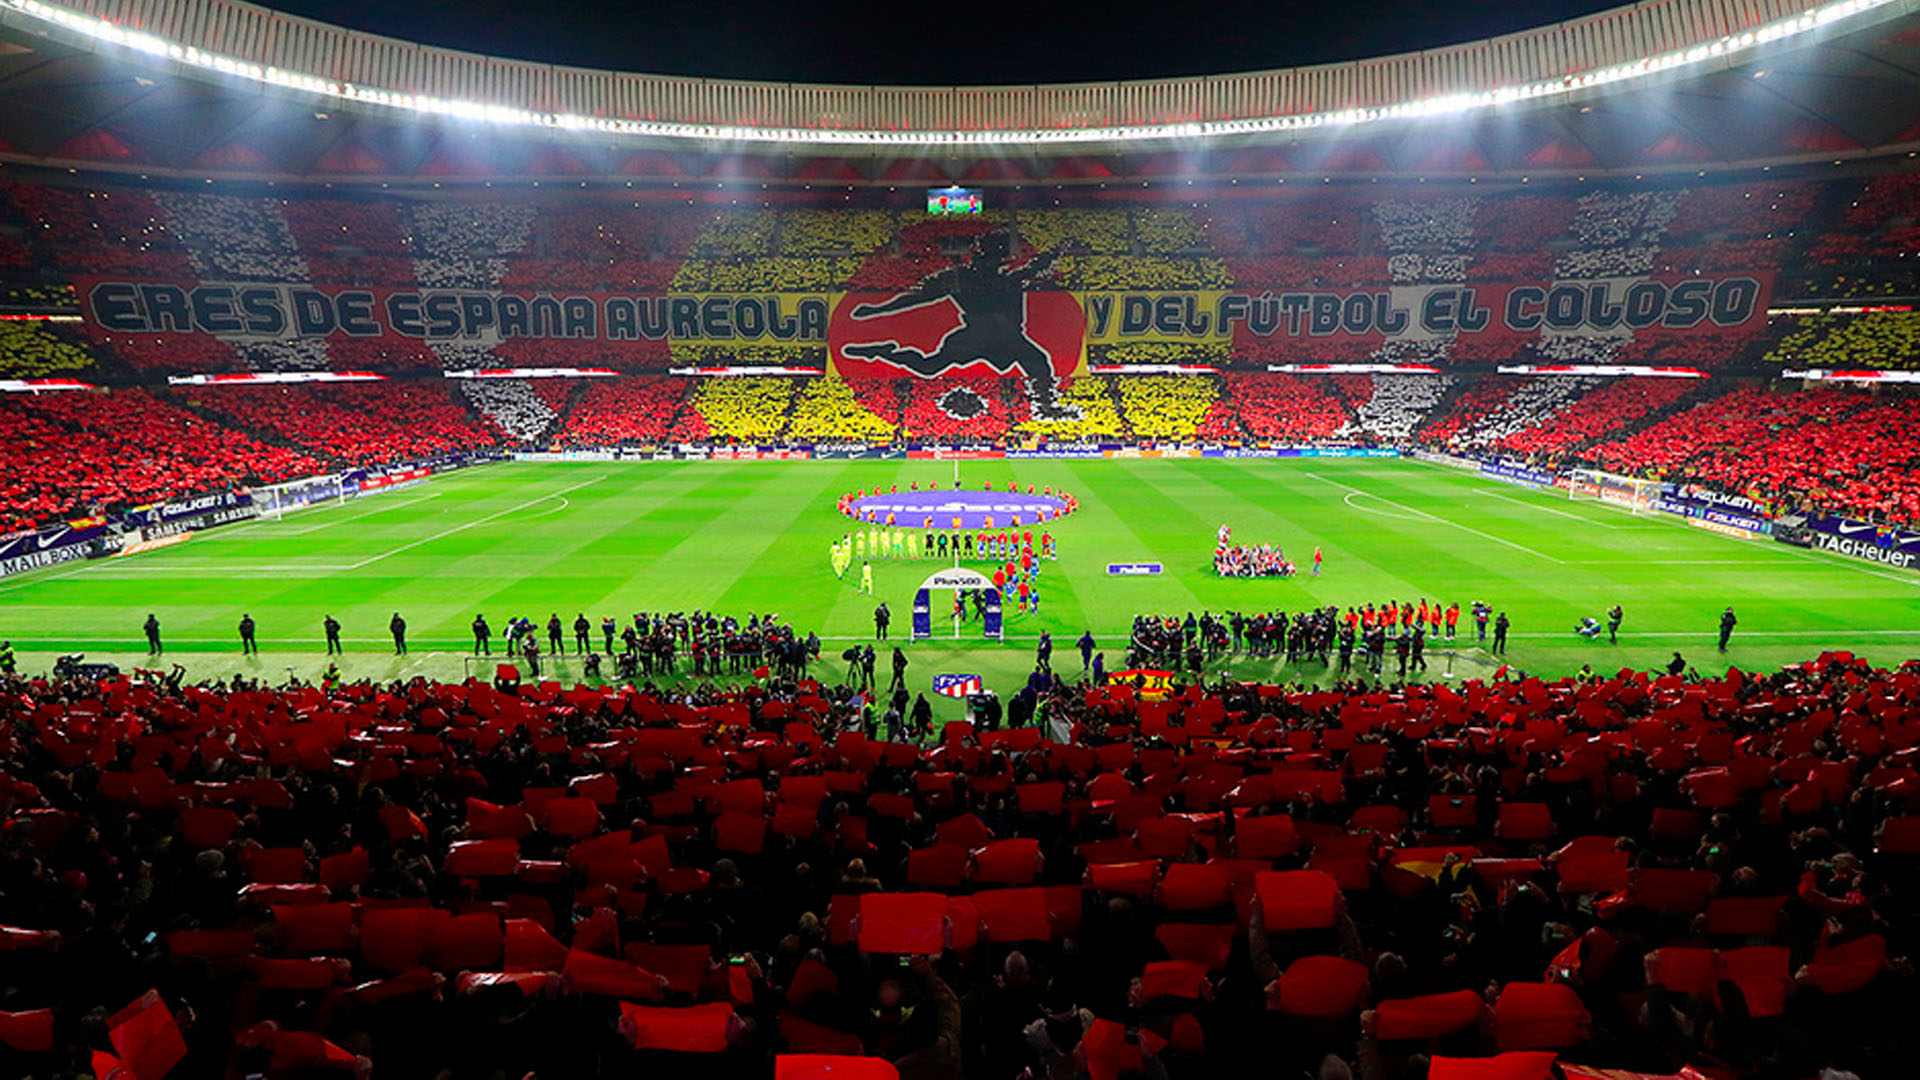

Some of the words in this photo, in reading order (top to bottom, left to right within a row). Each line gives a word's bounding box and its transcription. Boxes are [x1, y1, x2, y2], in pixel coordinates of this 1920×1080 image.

[89, 282, 285, 336] ERES
[292, 287, 382, 337] DE
[606, 294, 829, 341] AUREOLA
[1119, 294, 1212, 337] DEL
[1215, 290, 1410, 338] FÚTBOL
[1422, 286, 1491, 333] EL
[1504, 277, 1760, 331] COLOSO
[934, 577, 981, 586] Plus500
